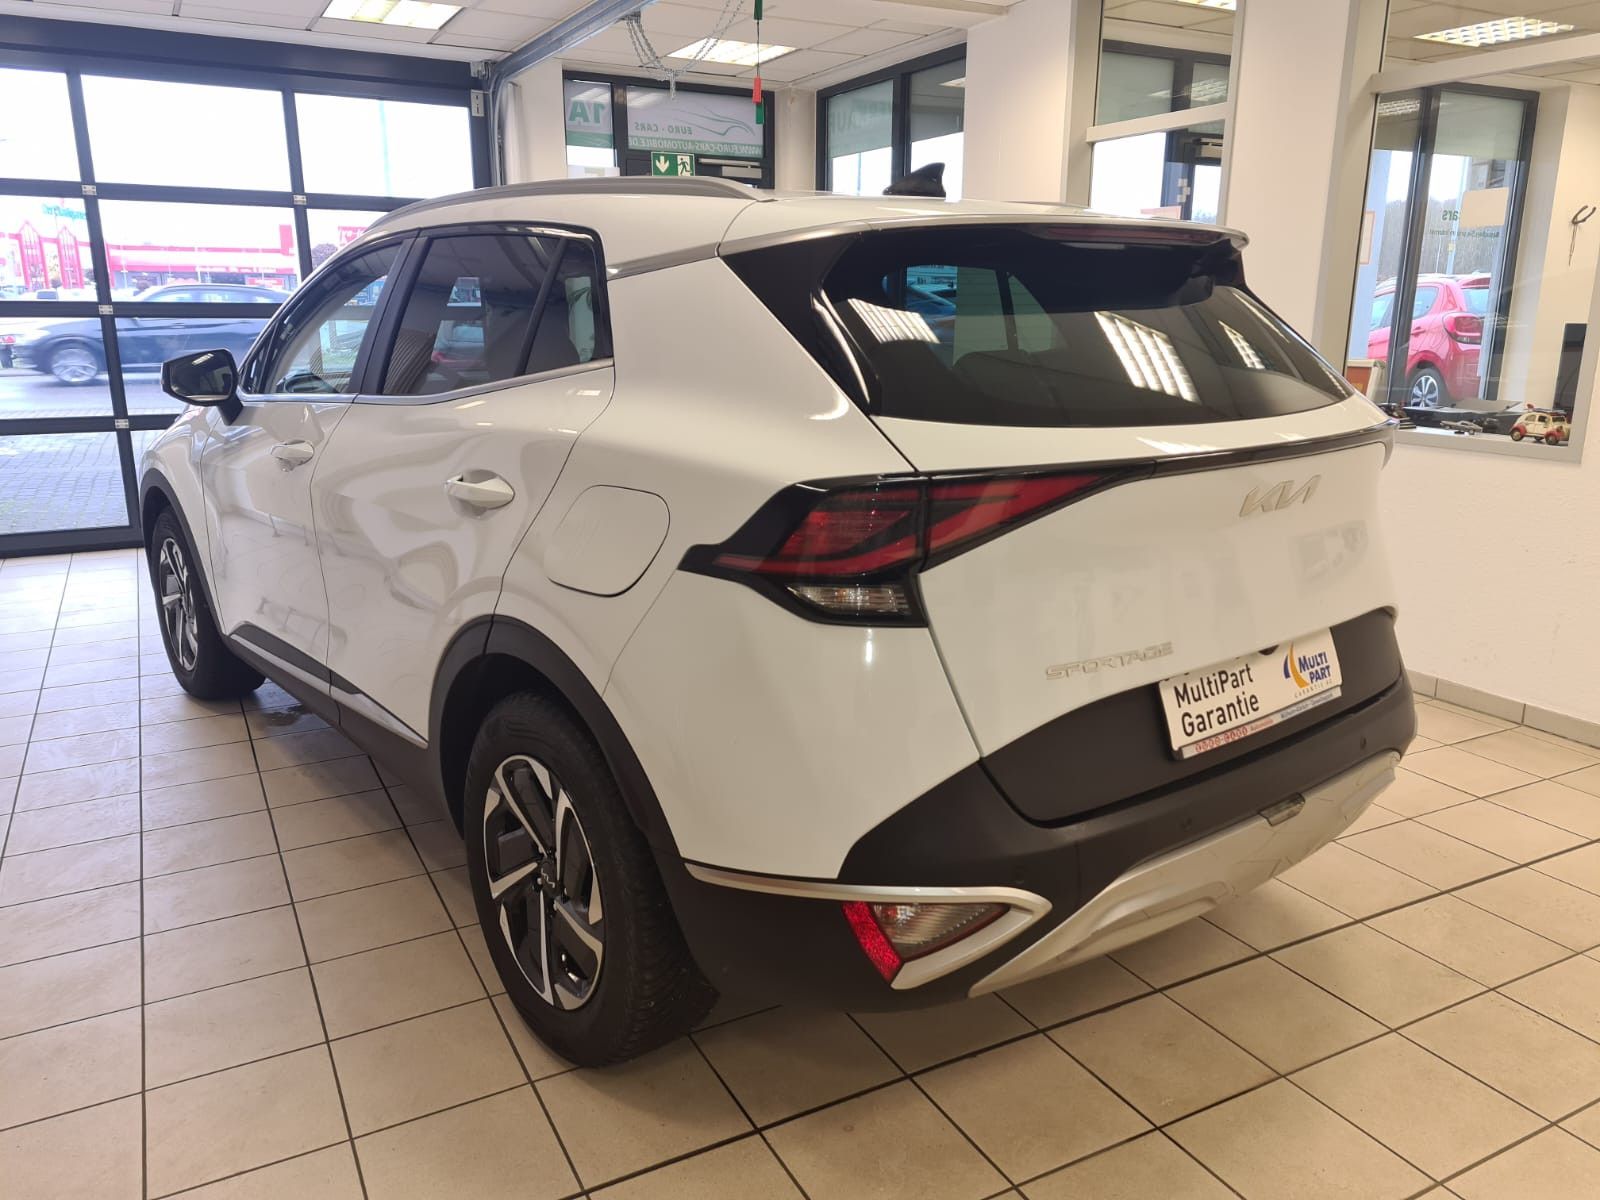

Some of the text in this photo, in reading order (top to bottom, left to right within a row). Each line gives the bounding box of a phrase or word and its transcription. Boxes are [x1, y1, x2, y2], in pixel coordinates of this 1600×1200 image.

[1239, 474, 1322, 517] KIA
[1046, 641, 1174, 680] SPORTAGE
[1298, 651, 1328, 673] MULTI
[1309, 665, 1331, 684] PART
[1174, 663, 1254, 708] MultiPart
[1181, 691, 1260, 738] Garantie
